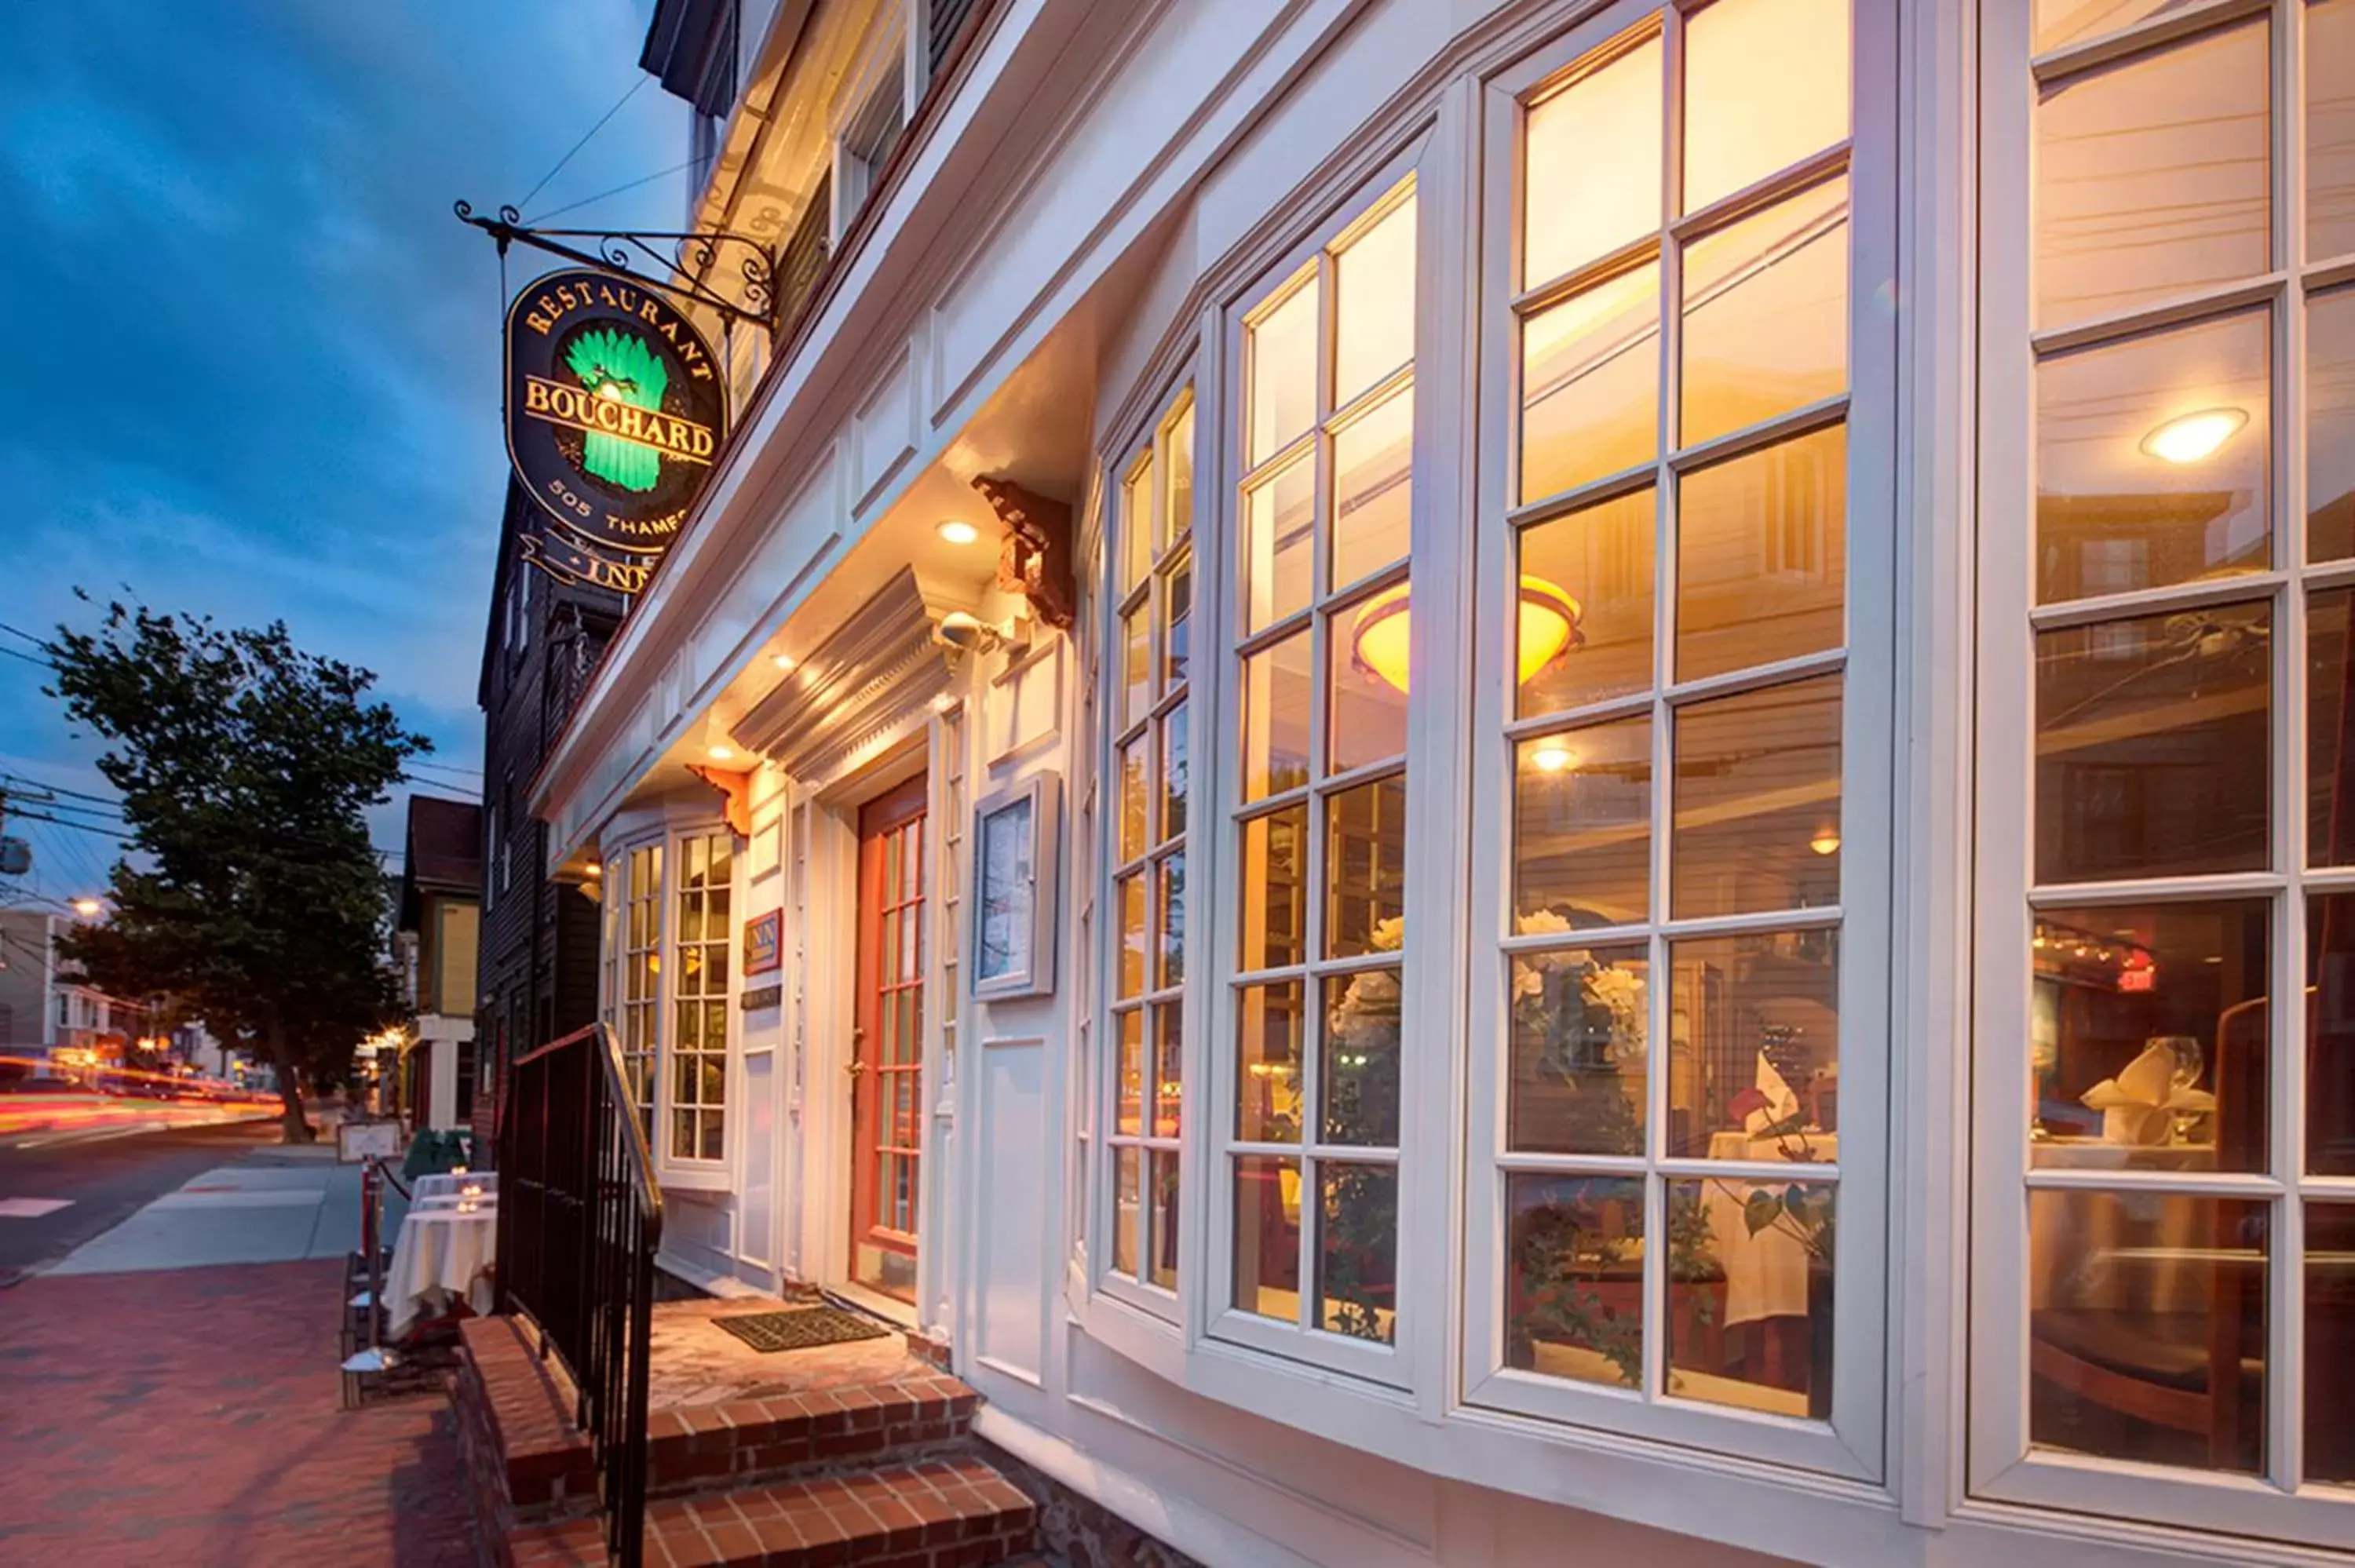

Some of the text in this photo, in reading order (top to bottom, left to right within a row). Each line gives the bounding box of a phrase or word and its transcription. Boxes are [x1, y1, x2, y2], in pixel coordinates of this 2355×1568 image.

[526, 282, 713, 381] RESTAURANT
[525, 381, 714, 457] BOUCHARD
[548, 479, 592, 517] 505
